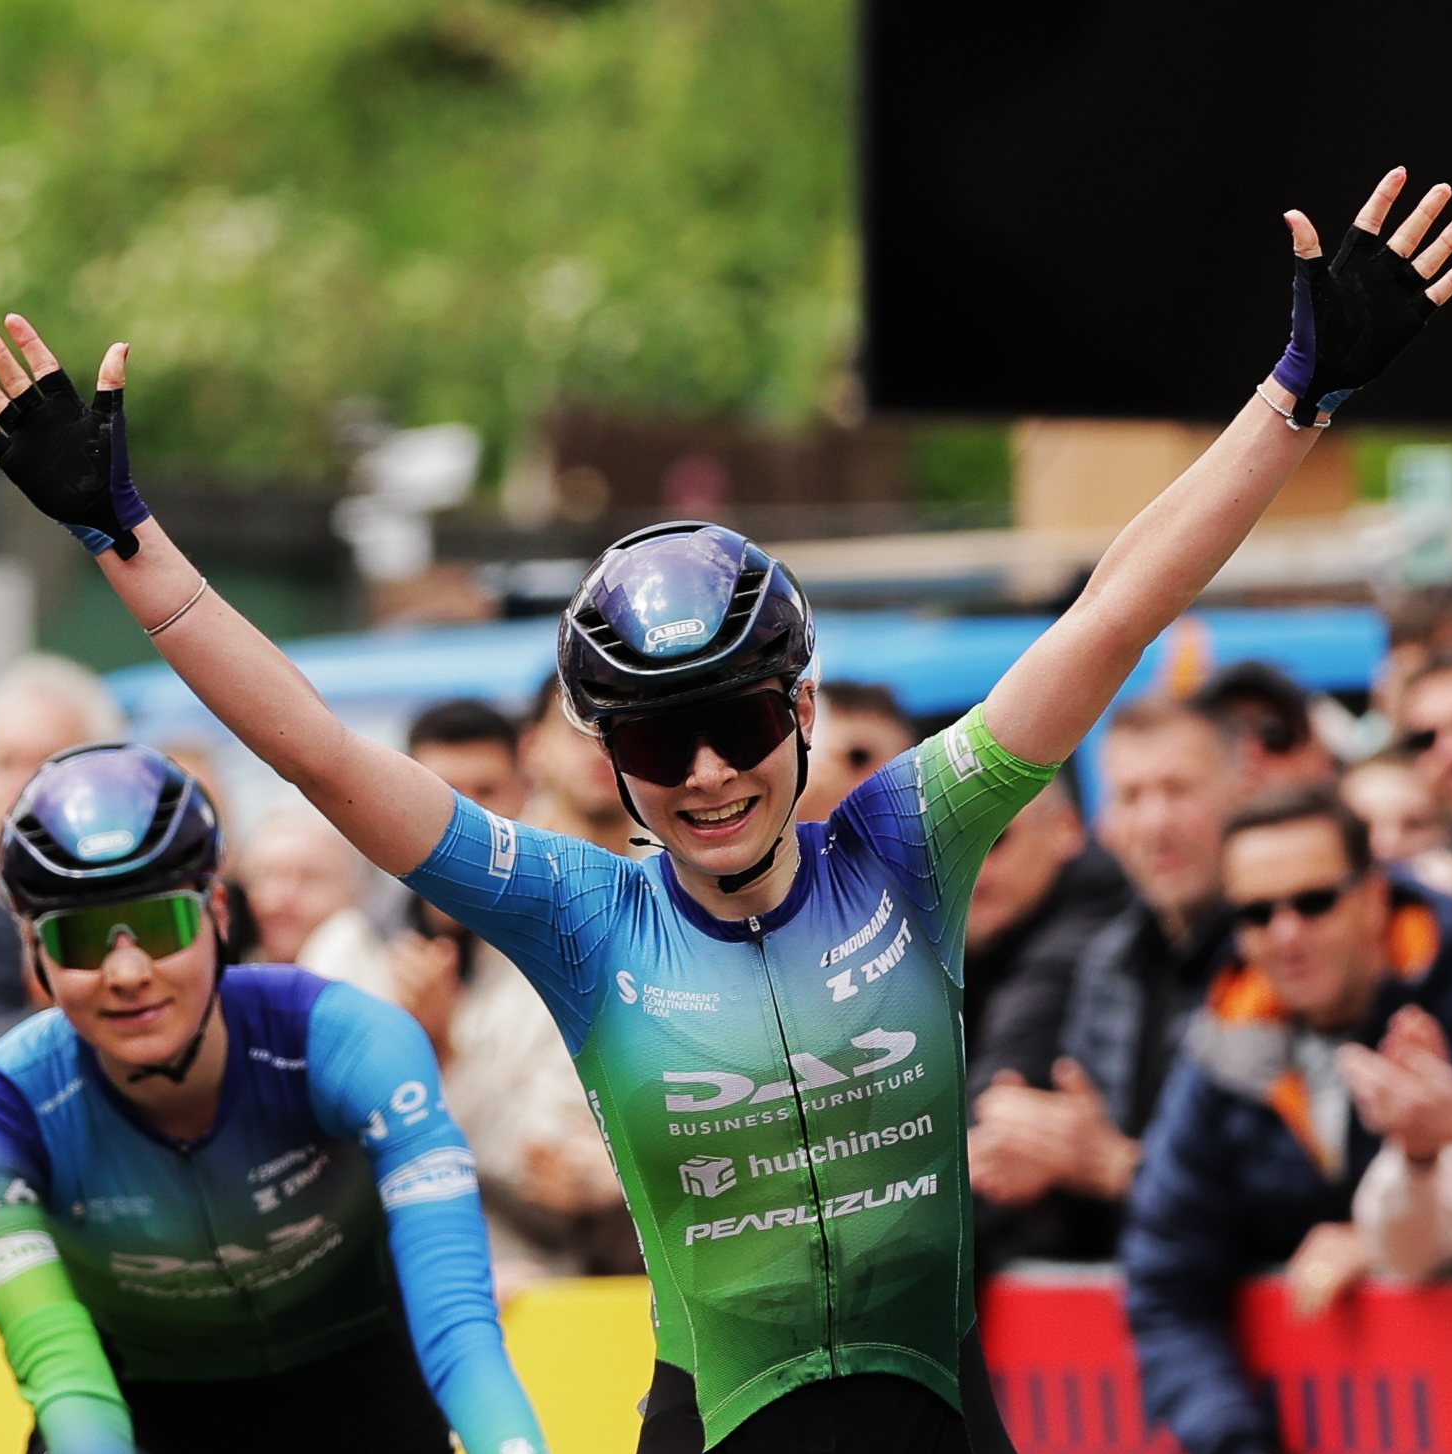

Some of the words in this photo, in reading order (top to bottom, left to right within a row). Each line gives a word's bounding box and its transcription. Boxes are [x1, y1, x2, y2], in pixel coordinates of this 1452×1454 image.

[654, 621, 698, 640] ABUS
[860, 917, 912, 983] ZWIFT
[642, 995, 718, 1012] CONTINENTAL
[642, 1004, 670, 1018] TEAM
[643, 984, 665, 997] UCI
[666, 989, 720, 1002] WOMEN'S
[662, 1028, 917, 1112] DAS
[669, 1108, 789, 1136] BUSINESS
[801, 1062, 924, 1114] FURNITURE
[749, 1114, 933, 1178] hutchinson
